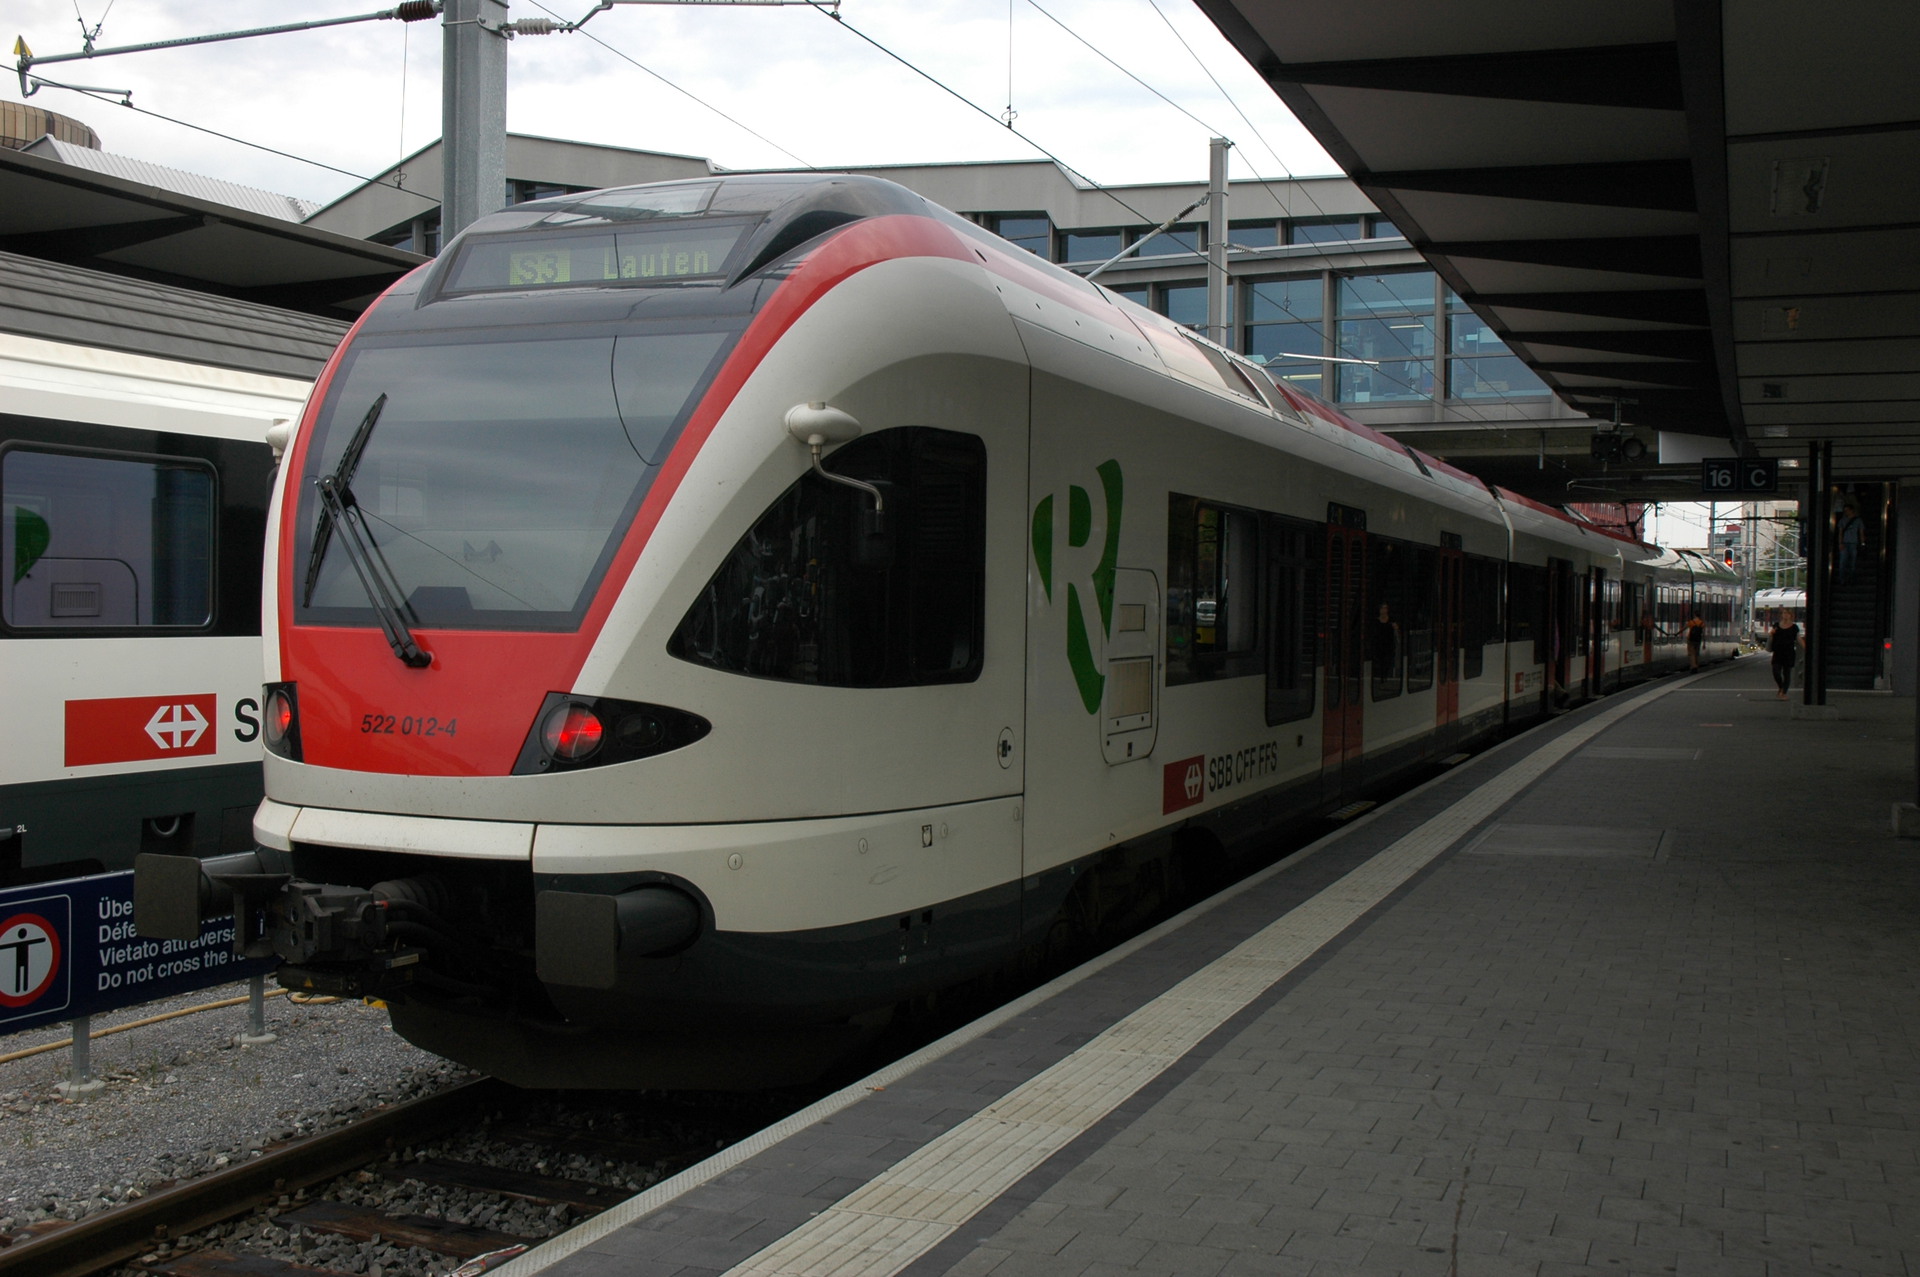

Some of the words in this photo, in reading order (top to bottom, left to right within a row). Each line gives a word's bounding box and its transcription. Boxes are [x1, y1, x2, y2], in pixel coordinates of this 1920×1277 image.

[518, 252, 559, 284] S3
[603, 246, 709, 280] Laufen
[1709, 468, 1732, 487] 16
[1750, 468, 1767, 487] C
[361, 713, 397, 734] 522
[401, 715, 458, 737] 012-4
[1208, 754, 1233, 792] SBB
[1235, 747, 1257, 783] CFF
[1259, 741, 1278, 776] FFS
[16, 824, 28, 833] 2L
[99, 896, 134, 920] Übe
[99, 921, 138, 944] Défe
[99, 940, 159, 967] Vietato
[98, 973, 122, 992] Do
[126, 963, 154, 985] not
[157, 956, 200, 979] cross
[203, 950, 228, 968] the
